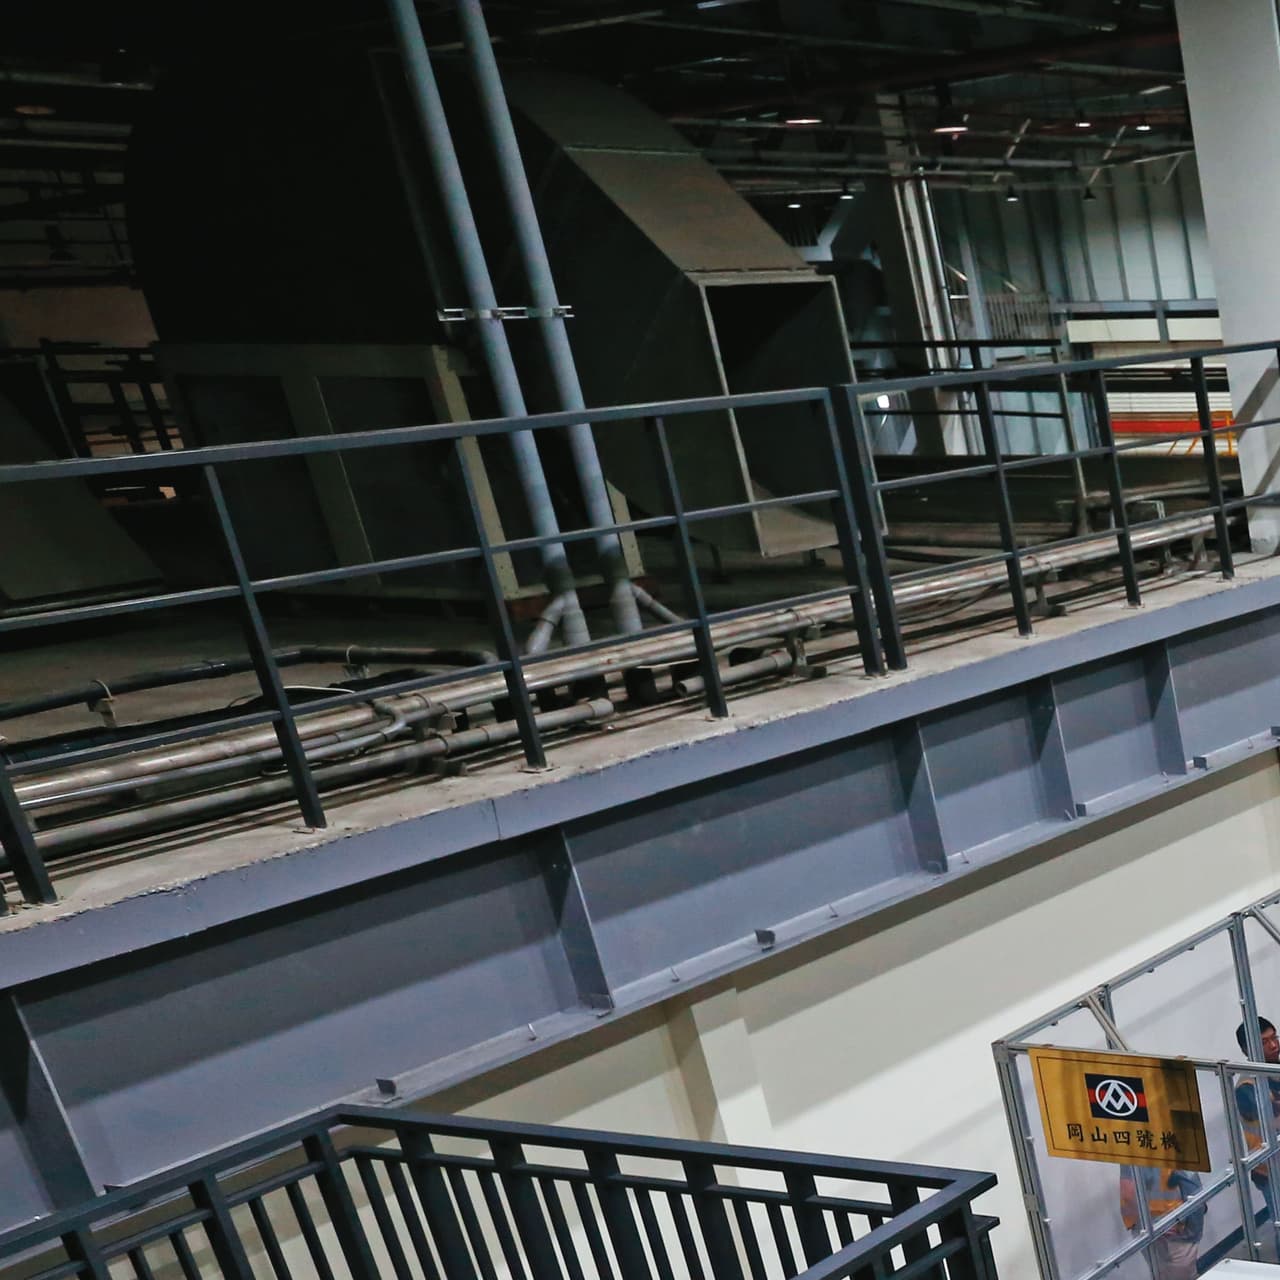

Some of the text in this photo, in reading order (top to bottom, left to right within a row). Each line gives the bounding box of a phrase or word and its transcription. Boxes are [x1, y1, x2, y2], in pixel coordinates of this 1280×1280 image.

[1067, 1123, 1181, 1152] 岡山四號機
